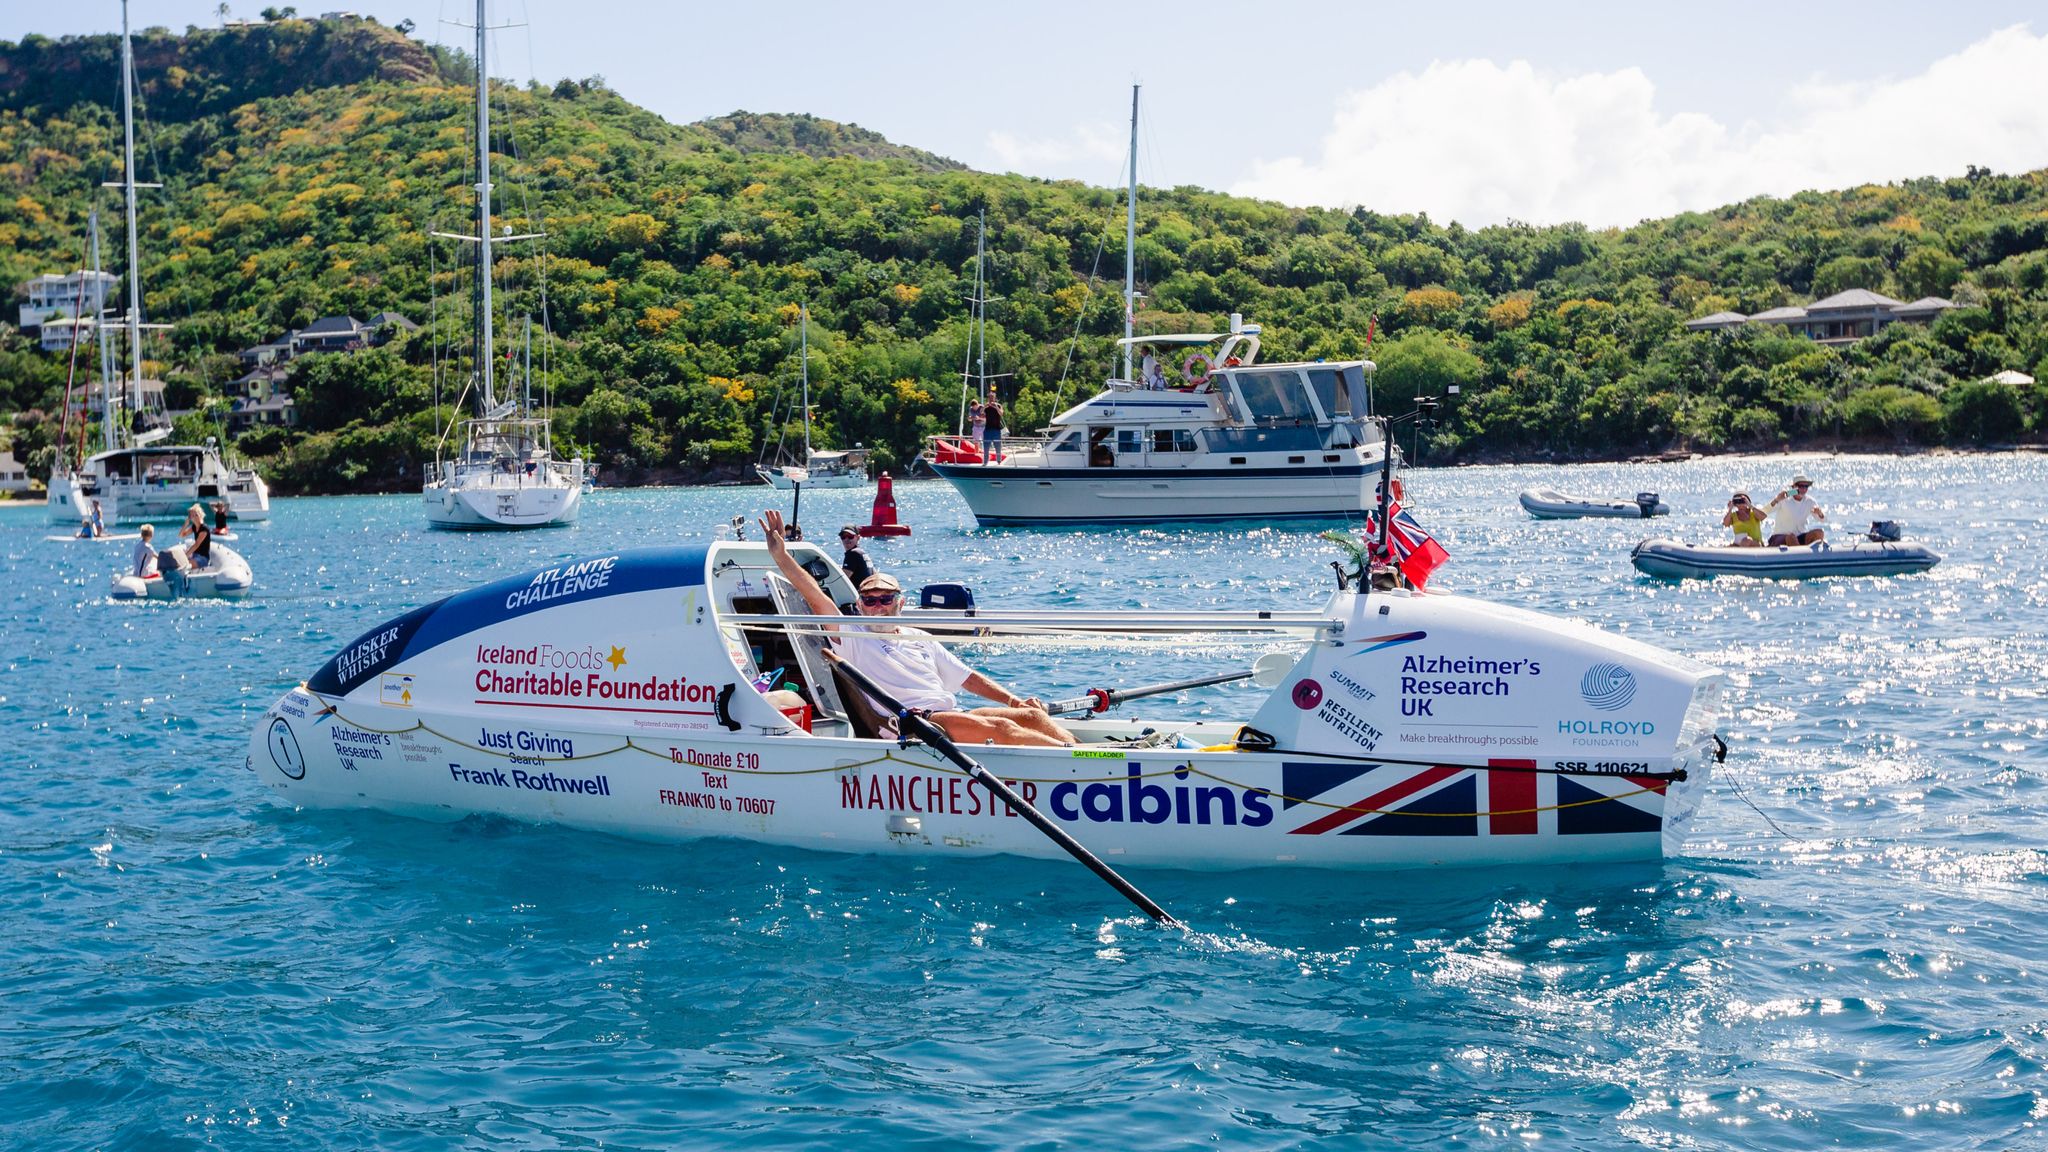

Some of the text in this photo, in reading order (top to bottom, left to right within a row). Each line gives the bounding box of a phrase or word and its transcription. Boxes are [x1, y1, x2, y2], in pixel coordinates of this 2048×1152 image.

[530, 556, 619, 587] ATLANTIC
[506, 570, 612, 610] CHALLENGE
[336, 626, 399, 673] TALISKER
[477, 644, 603, 670] Iceland Foods
[337, 645, 388, 686] WHISKY
[1401, 655, 1541, 675] Alzheimer's
[475, 669, 716, 703] Charitable Foundation
[1330, 670, 1376, 701] SUMMIT
[1401, 676, 1509, 696] Research
[1401, 698, 1433, 717] UK
[662, 721, 680, 730] charity
[1318, 708, 1376, 752] NUTRITION
[1325, 699, 1383, 741] RESILIENT
[1558, 720, 1655, 735] HOLROYD
[331, 726, 391, 746] Alzheimer's
[478, 728, 573, 759] Just Giving
[1400, 733, 1539, 747] Make breakthroughs possible
[1572, 738, 1639, 747] FOUNDATION
[334, 742, 383, 760] Research
[509, 752, 545, 767] Search
[669, 747, 759, 770] To Donate £10
[1073, 750, 1097, 758] SAFETY
[340, 758, 358, 772] UK
[1555, 761, 1649, 774] SSR 110621
[449, 763, 610, 796] Frank Rothwell
[701, 772, 728, 789] Text
[659, 790, 775, 815] FRANK10 to 70607
[1050, 762, 1274, 827] cabins
